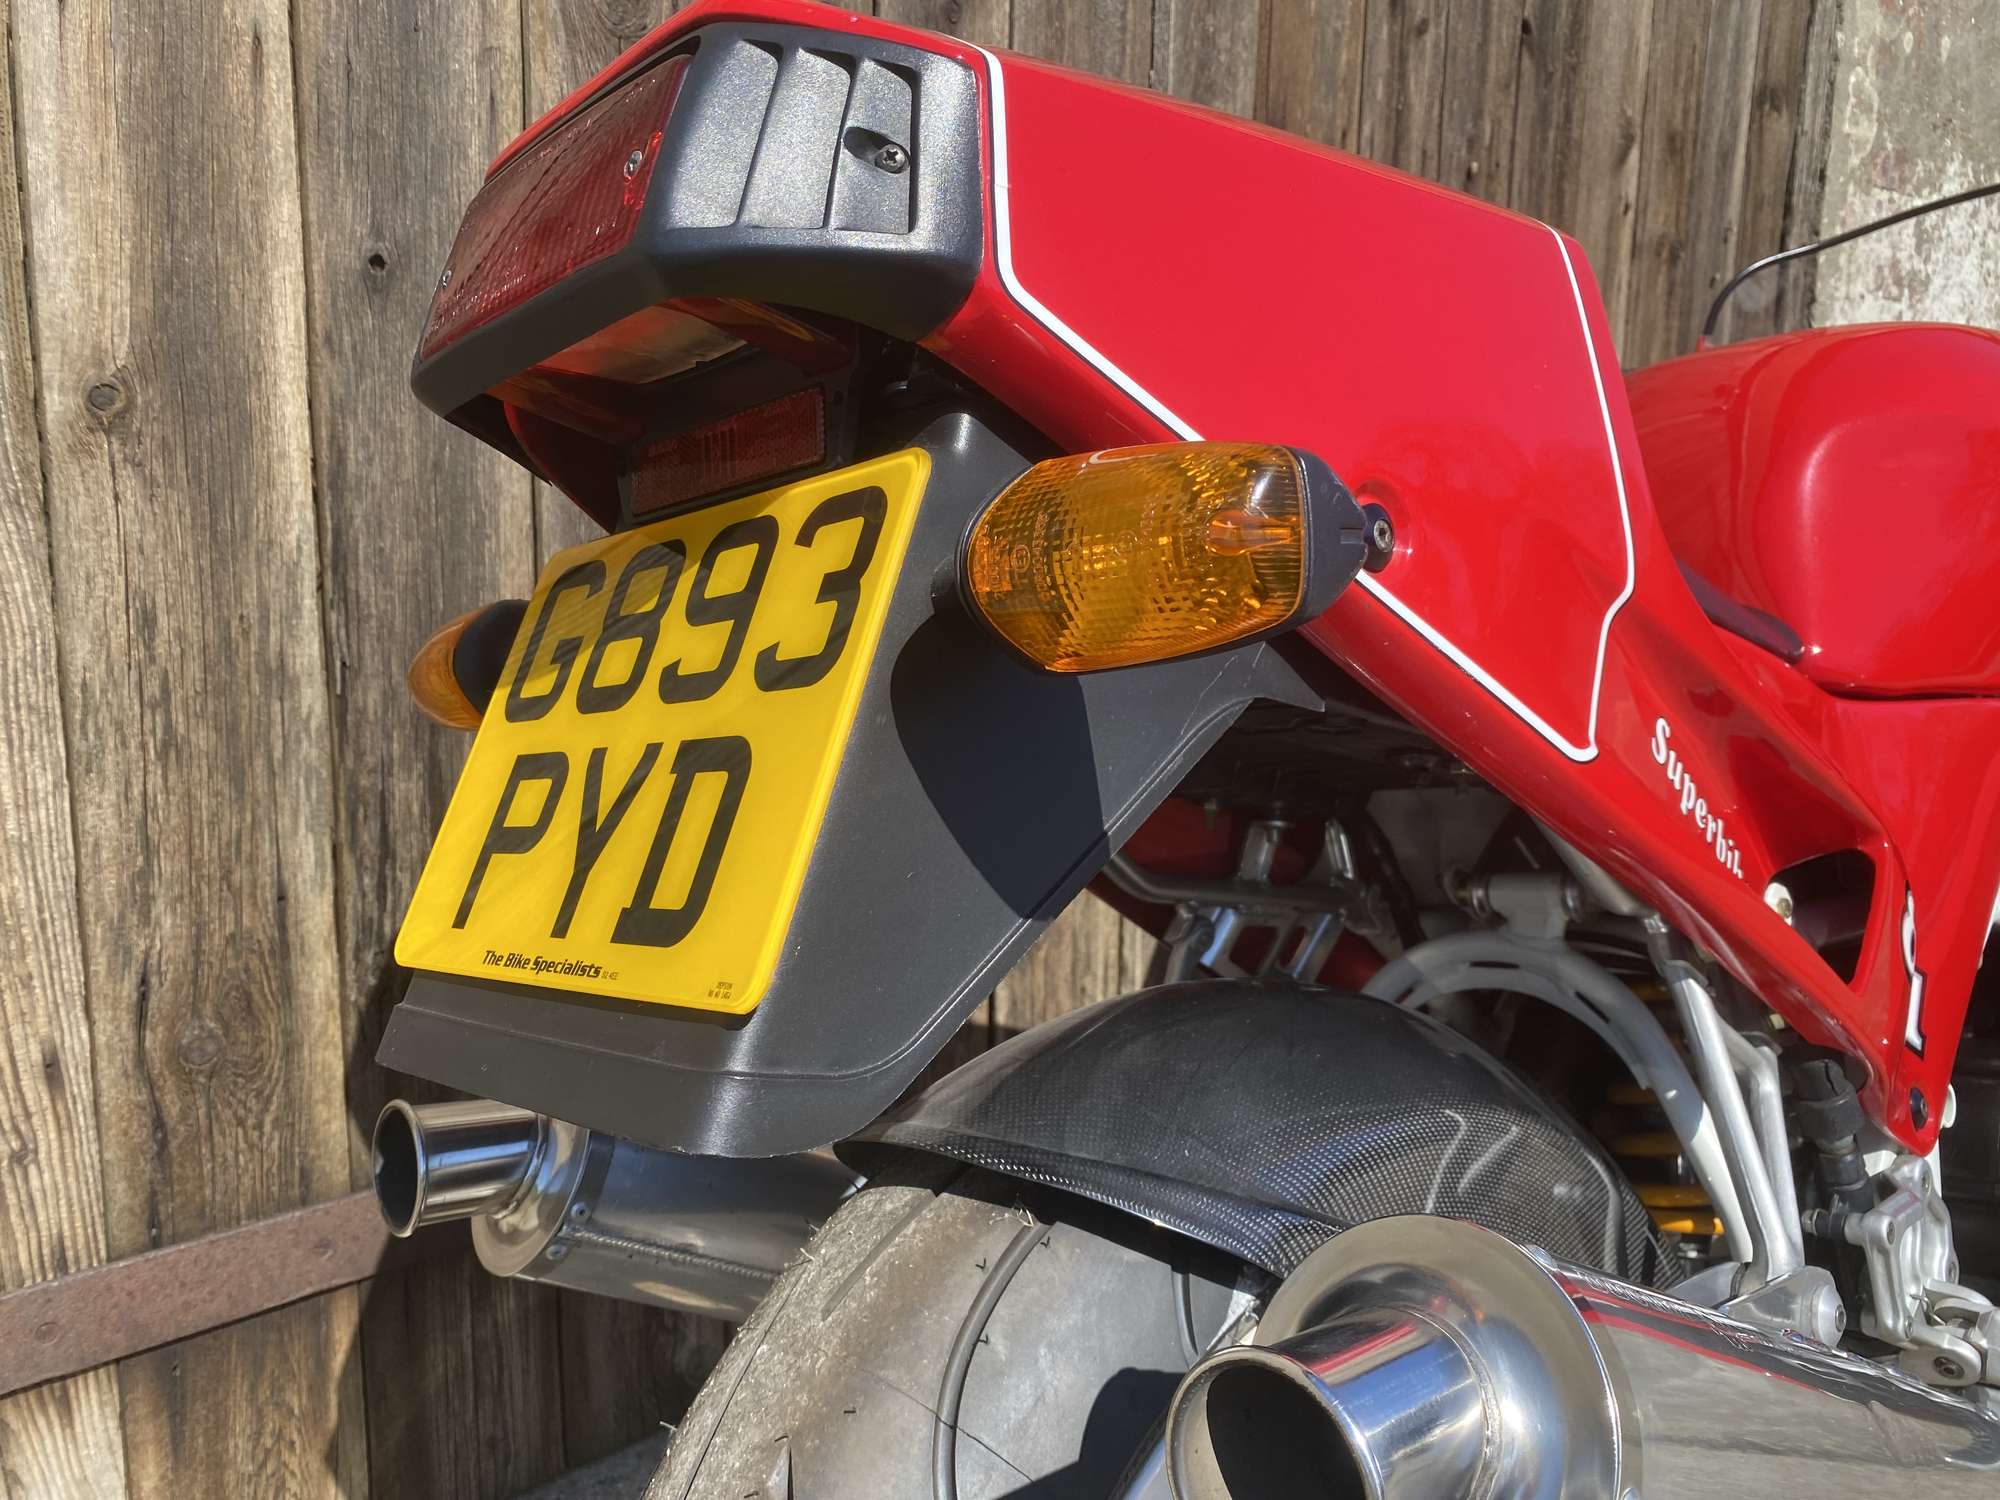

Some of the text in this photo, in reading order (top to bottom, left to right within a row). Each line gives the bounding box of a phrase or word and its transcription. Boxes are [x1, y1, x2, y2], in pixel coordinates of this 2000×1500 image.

[504, 485, 888, 723] G893
[451, 735, 753, 948] PYD
[482, 950, 505, 966] The
[504, 952, 531, 970] Bike
[530, 955, 602, 978] Specialists
